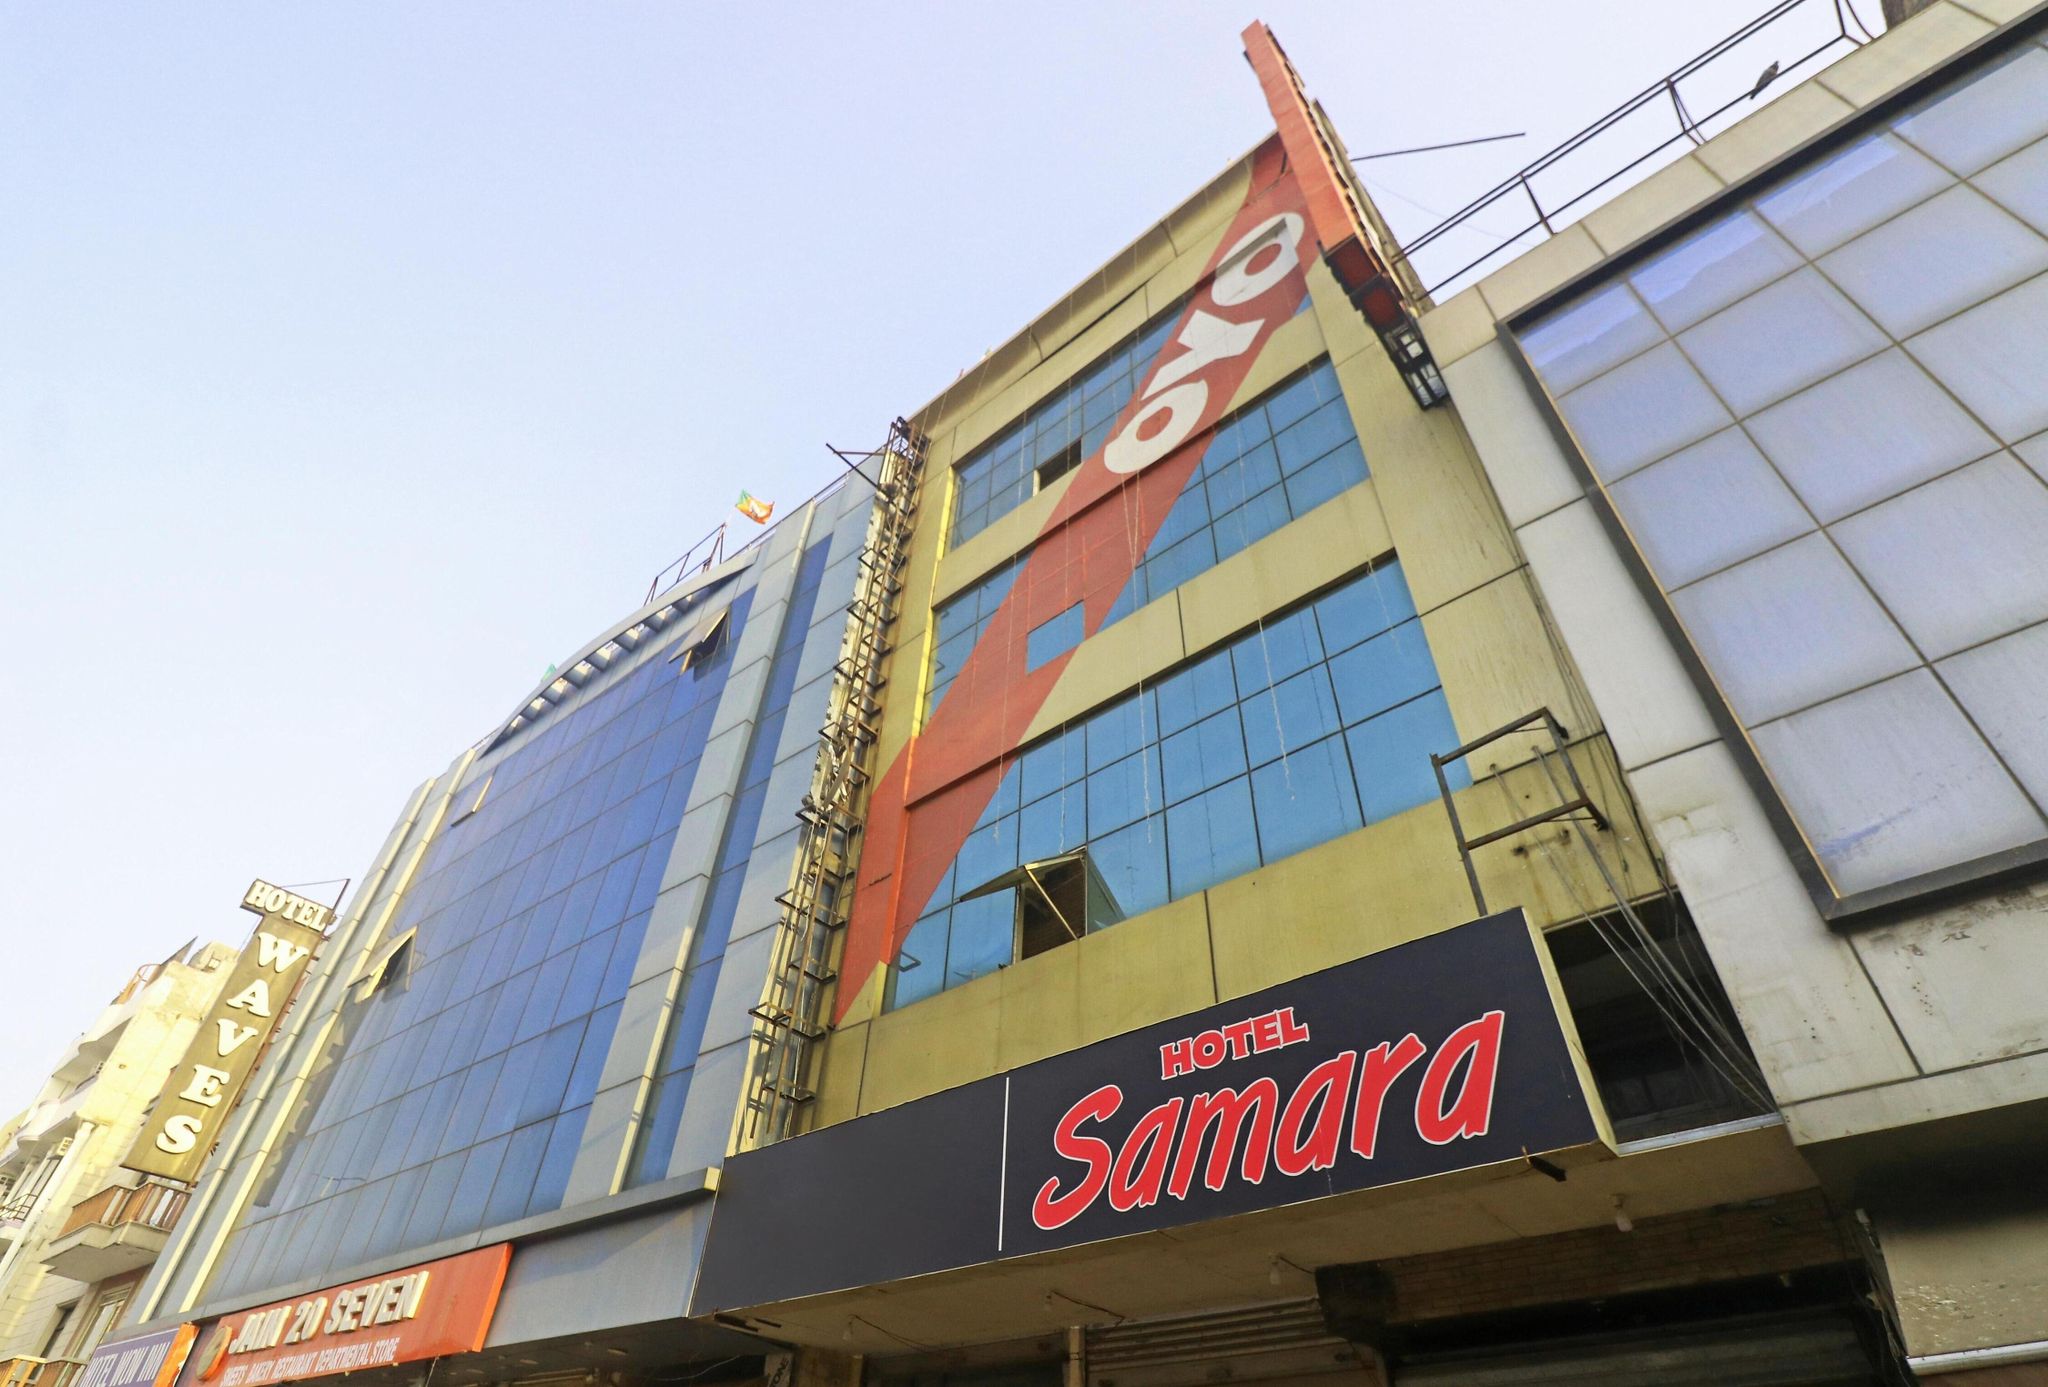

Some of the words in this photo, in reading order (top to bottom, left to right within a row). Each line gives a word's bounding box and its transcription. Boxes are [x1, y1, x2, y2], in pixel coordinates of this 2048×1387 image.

[244, 879, 332, 931] HOTEL
[155, 931, 309, 1154] WAVES
[1160, 1007, 1310, 1080] HOTEL
[1032, 1010, 1505, 1230] Samara
[228, 1305, 292, 1354] JAIN
[282, 1296, 328, 1345] 20
[323, 1270, 429, 1335] SEVEN
[77, 1353, 119, 1387] HOTEL
[108, 1345, 150, 1387] WOW
[136, 1341, 171, 1382] INN
[314, 1341, 373, 1373] DEPARTMENTAL
[370, 1337, 400, 1365] STORE
